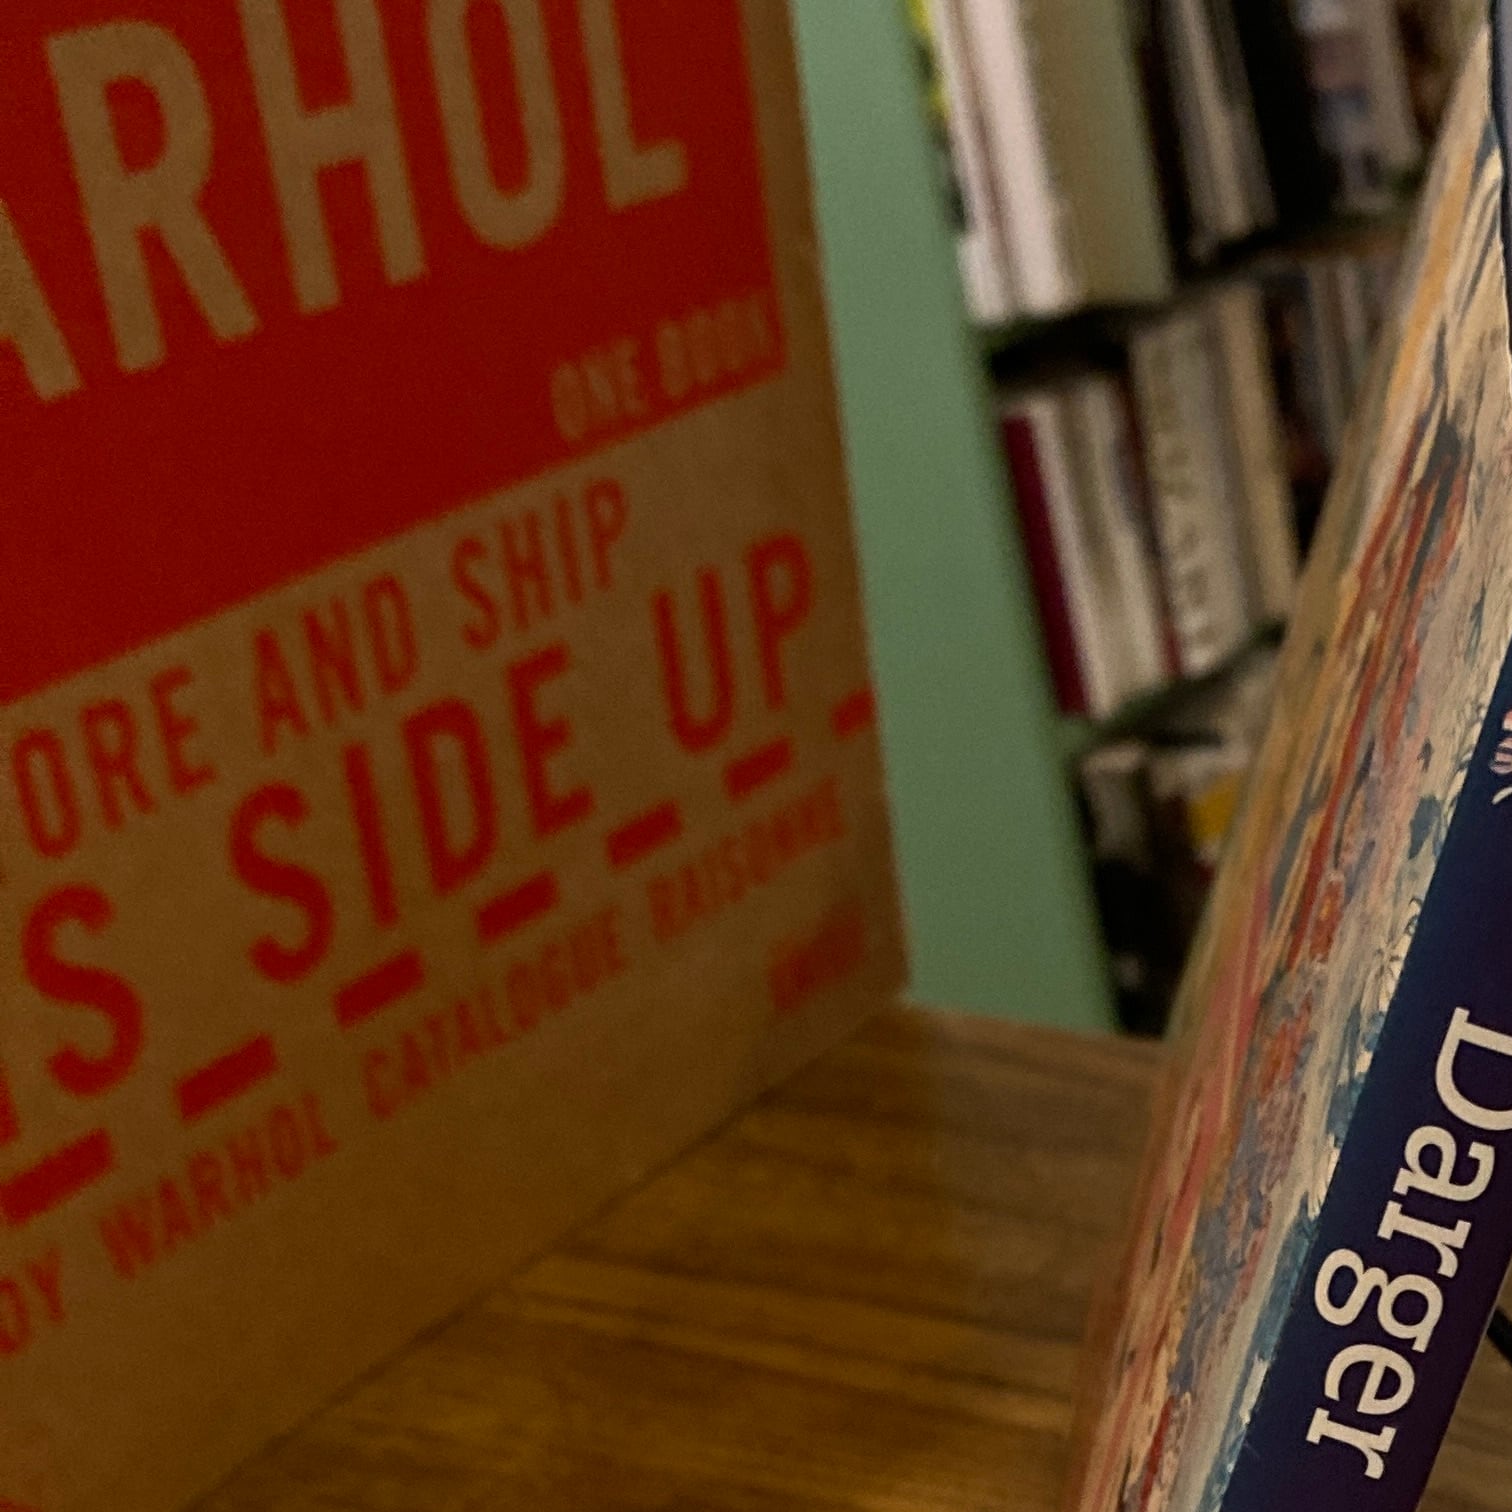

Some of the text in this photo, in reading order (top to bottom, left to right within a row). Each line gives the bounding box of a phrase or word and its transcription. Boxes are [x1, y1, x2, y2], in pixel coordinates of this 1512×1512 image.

[10, 478, 629, 859] ORE AND SHIP
[227, 640, 594, 985] SIDE
[652, 532, 814, 755] UP
[98, 1094, 339, 1281] WARHOL
[360, 907, 628, 1122] CATALOGUE
